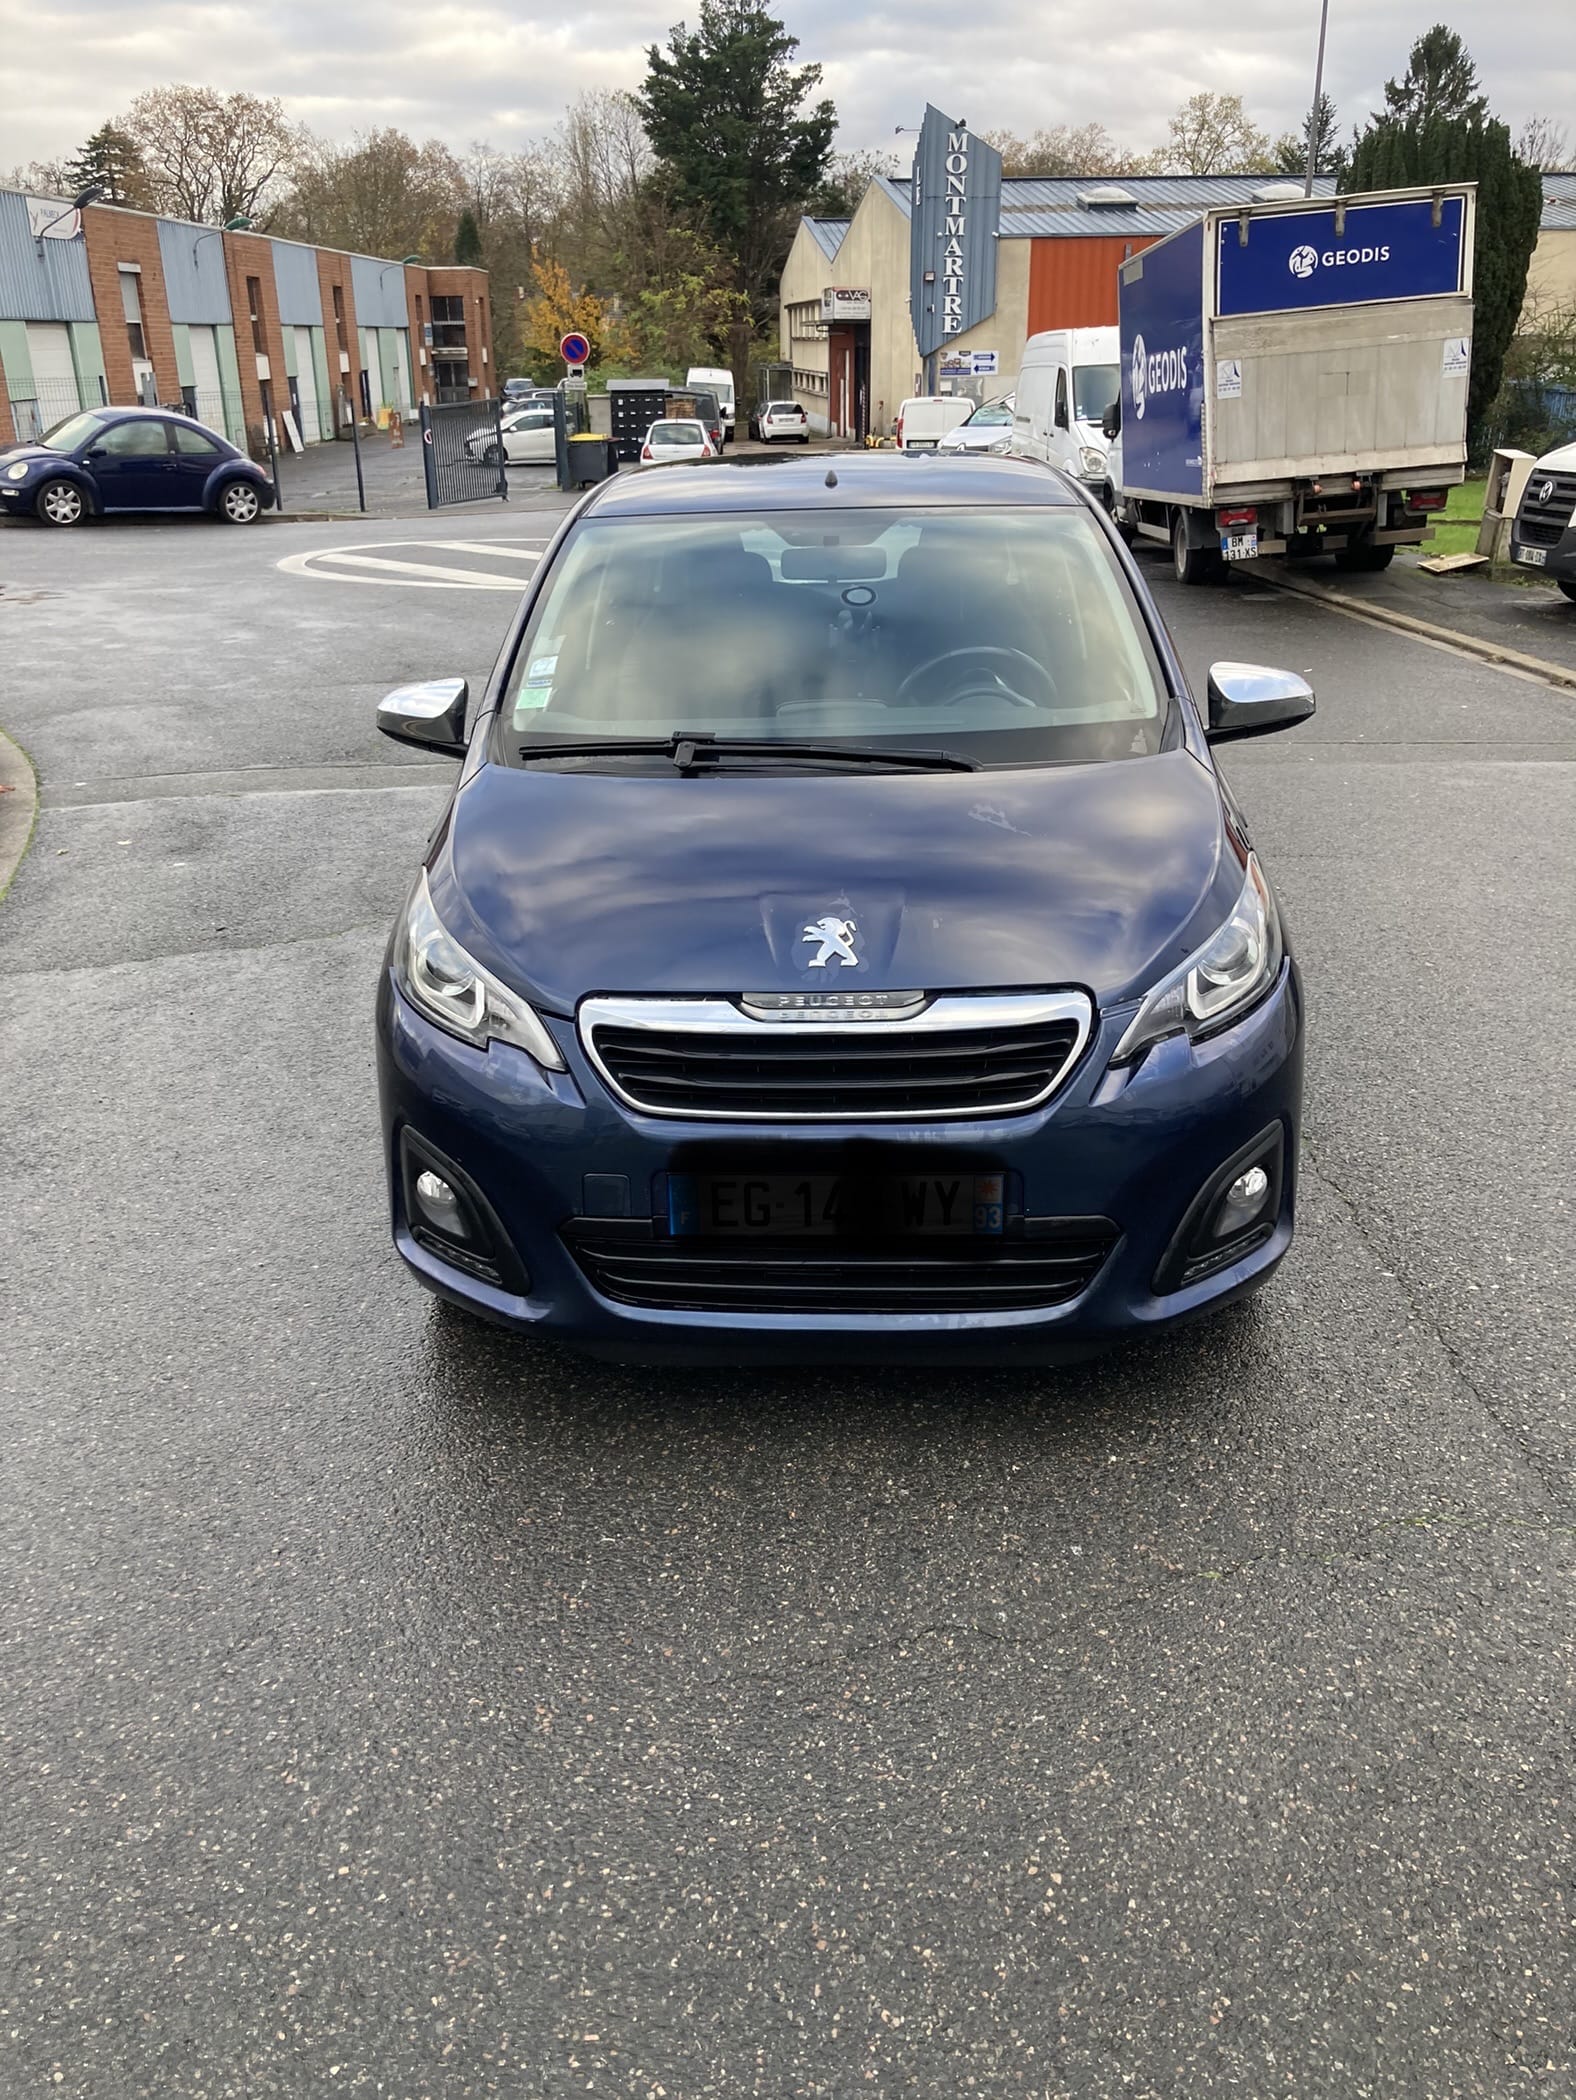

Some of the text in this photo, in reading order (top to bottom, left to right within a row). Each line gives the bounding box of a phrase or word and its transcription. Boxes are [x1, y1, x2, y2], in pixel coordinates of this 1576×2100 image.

[915, 166, 922, 206] LE
[942, 132, 969, 334] MONTMARTRE
[1322, 246, 1390, 266] GEODIS
[1148, 345, 1188, 394] GEODIS
[779, 995, 888, 1007] PEUGEOT
[680, 1211, 690, 1226] F
[976, 1205, 1001, 1229] 93
